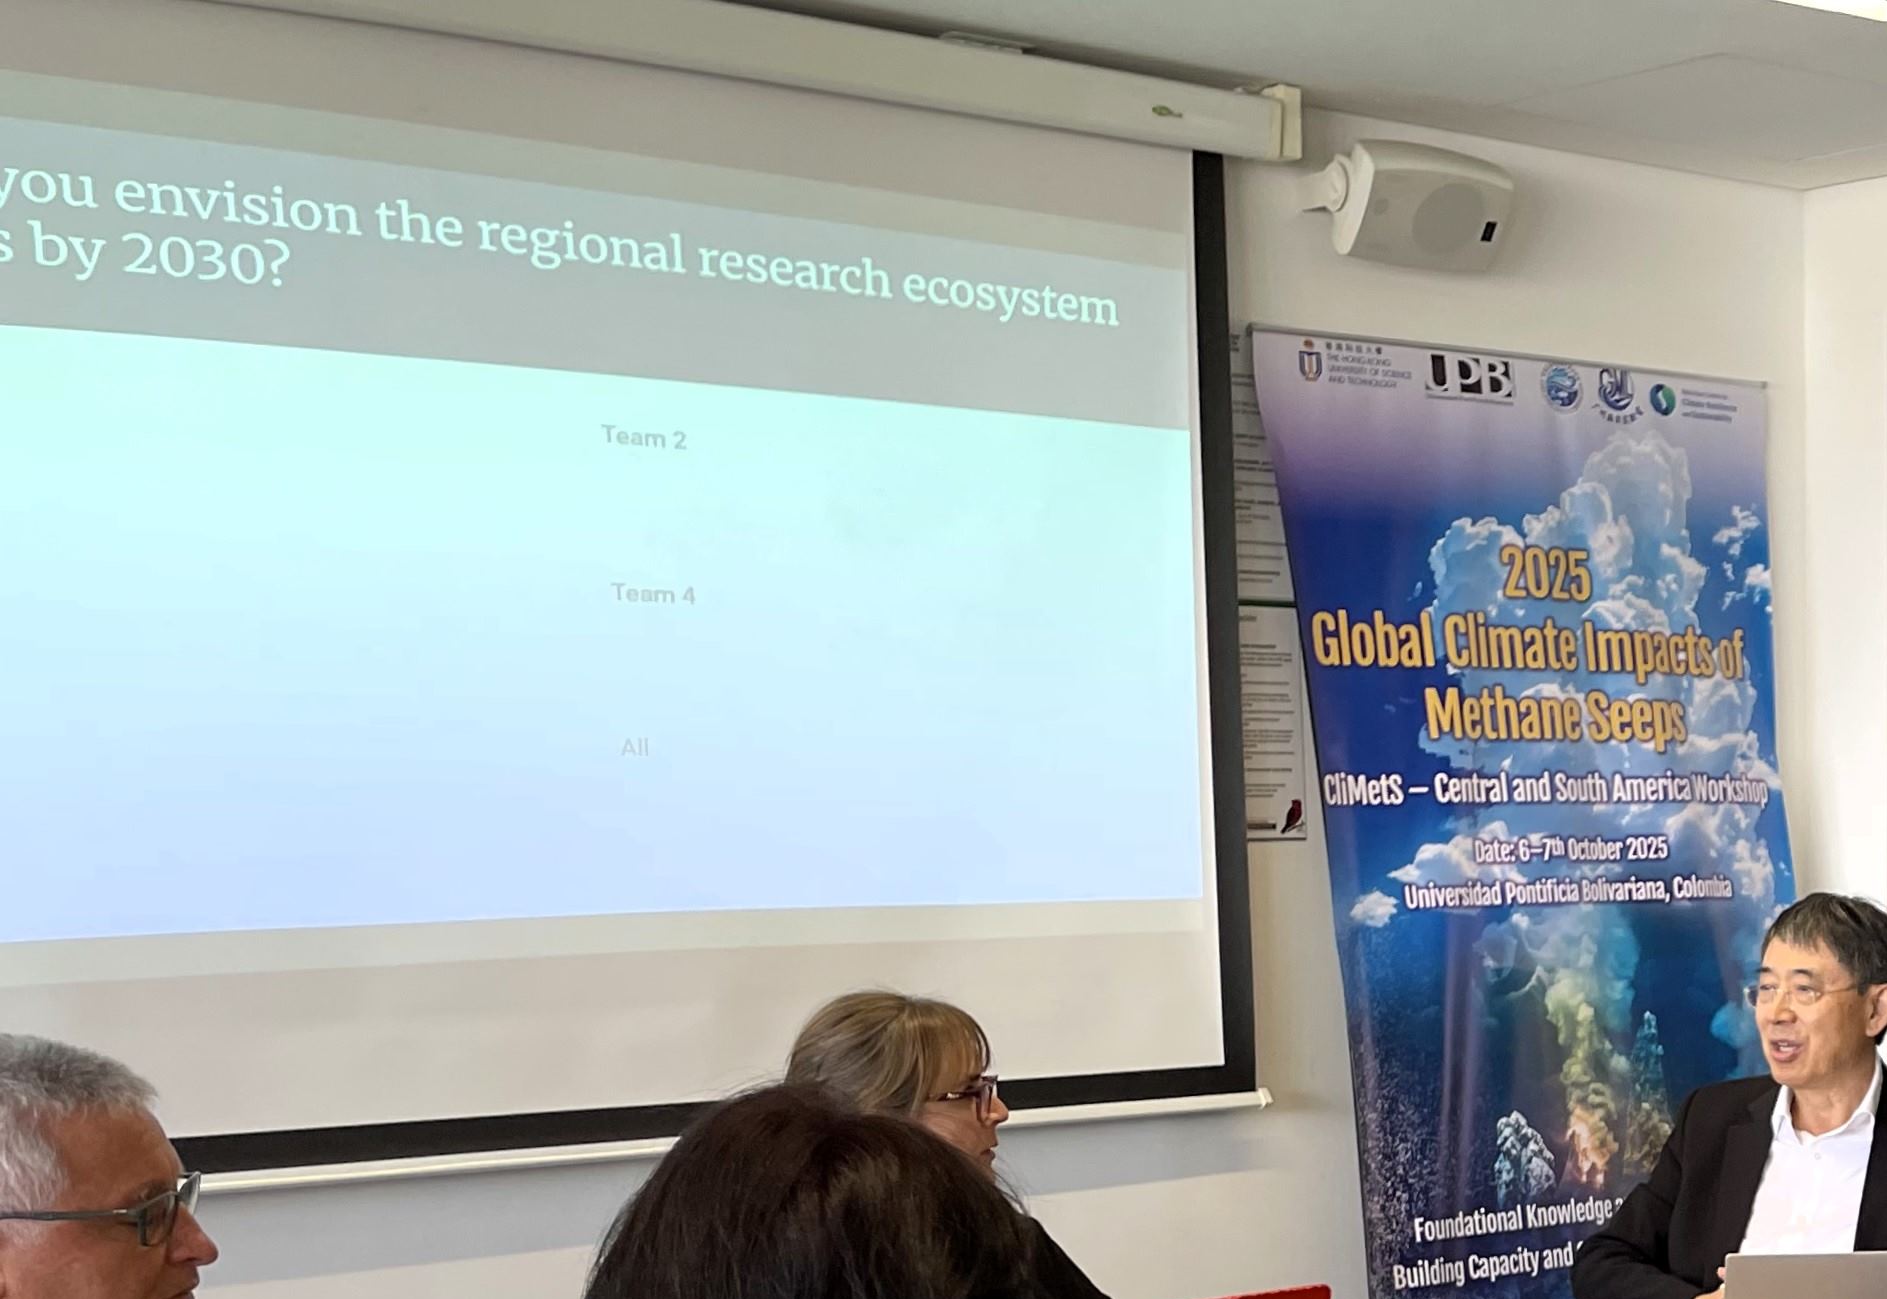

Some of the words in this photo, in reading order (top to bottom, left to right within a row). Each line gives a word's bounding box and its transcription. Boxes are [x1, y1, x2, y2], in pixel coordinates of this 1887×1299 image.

[26, 219, 107, 281] by
[122, 231, 292, 288] 2030?
[114, 178, 363, 236] envision
[376, 199, 464, 248] the
[478, 219, 687, 274] regional
[698, 246, 894, 300] research
[902, 272, 1121, 327] ecosystem
[1425, 353, 1514, 398] UPB
[601, 423, 667, 450] Team
[673, 430, 688, 450] 2
[610, 582, 676, 605] Team
[682, 585, 697, 606] 4
[1501, 545, 1592, 602] 2025
[1312, 609, 1435, 668] Global
[1444, 613, 1577, 671] Climate
[1584, 621, 1714, 684] Impacts
[1719, 629, 1745, 679] of
[1424, 687, 1581, 741] Methane
[1586, 690, 1688, 753] Seeps
[620, 736, 650, 758] All
[1323, 772, 1404, 806] CliMetS
[1433, 770, 1508, 803] Central
[1513, 770, 1551, 802] and
[1554, 771, 1607, 802] South
[1612, 770, 1691, 802] America
[1692, 773, 1768, 807] Workshop
[1474, 838, 1515, 863] Date:
[1568, 837, 1623, 861] October
[1626, 836, 1668, 861] 2025
[1404, 881, 1501, 909] Universidad
[1505, 878, 1580, 906] Pontificia
[1582, 876, 1670, 904] Bolivariana,
[1673, 874, 1732, 899] Colombia
[1414, 1204, 1523, 1243] Foundational
[1526, 1195, 1613, 1229] Knowledge
[1393, 1257, 1465, 1290] Building
[1468, 1244, 1540, 1282] Capacity
[1543, 1241, 1574, 1270] and
